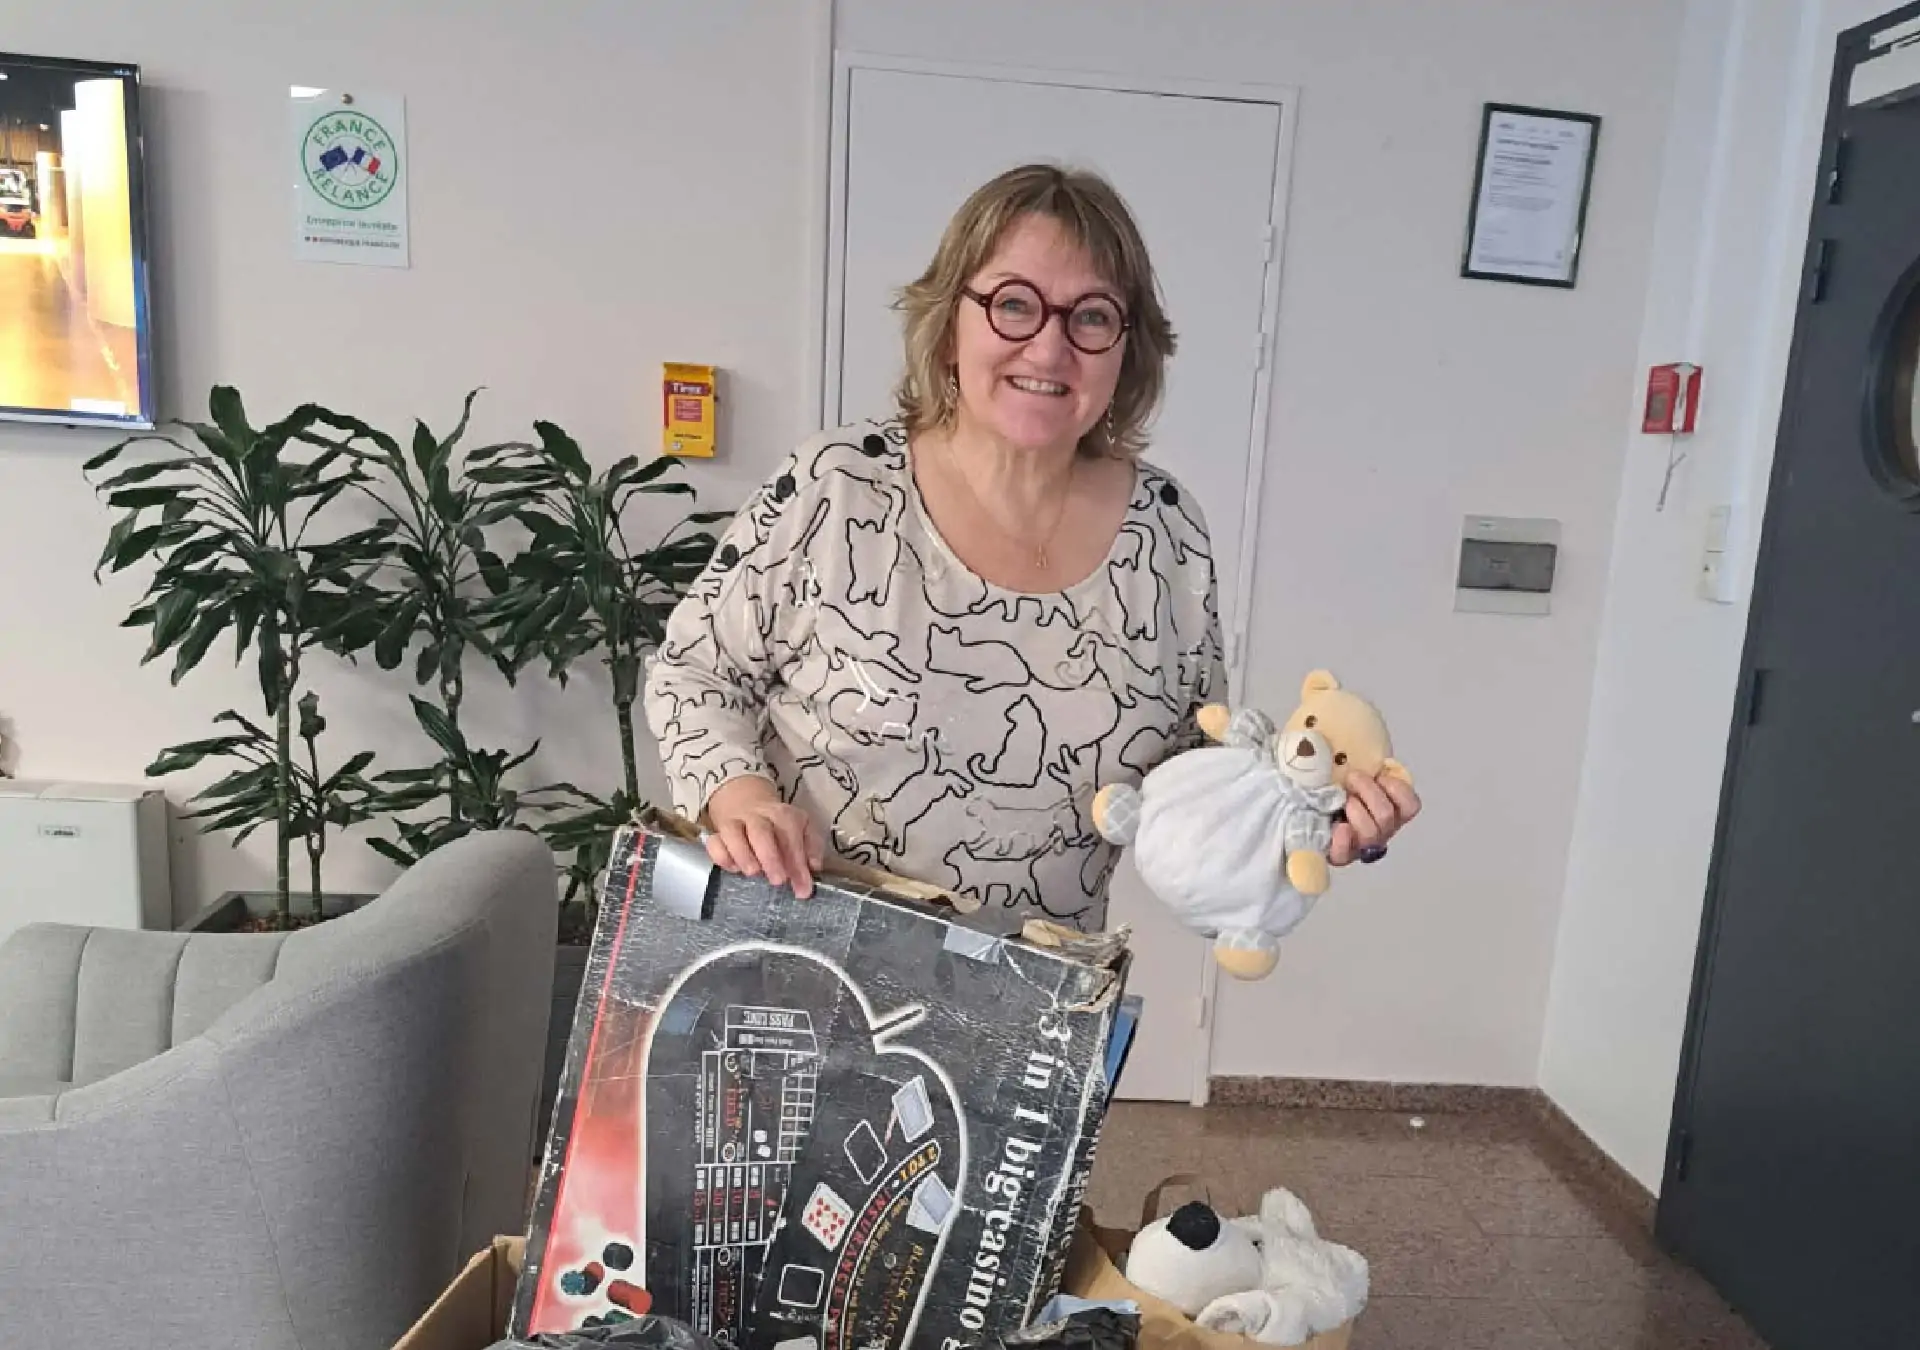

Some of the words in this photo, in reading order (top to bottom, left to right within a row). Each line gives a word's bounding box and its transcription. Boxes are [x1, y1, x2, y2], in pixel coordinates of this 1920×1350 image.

[312, 119, 386, 151] FRANCE
[312, 167, 388, 203] RELANCE
[1038, 1013, 1072, 1042] 3
[1023, 1050, 1065, 1089] in
[985, 1136, 1042, 1200] big
[833, 1187, 892, 1299] INSURANCE
[896, 1242, 925, 1300] BLACK
[959, 1209, 1013, 1329] casino
